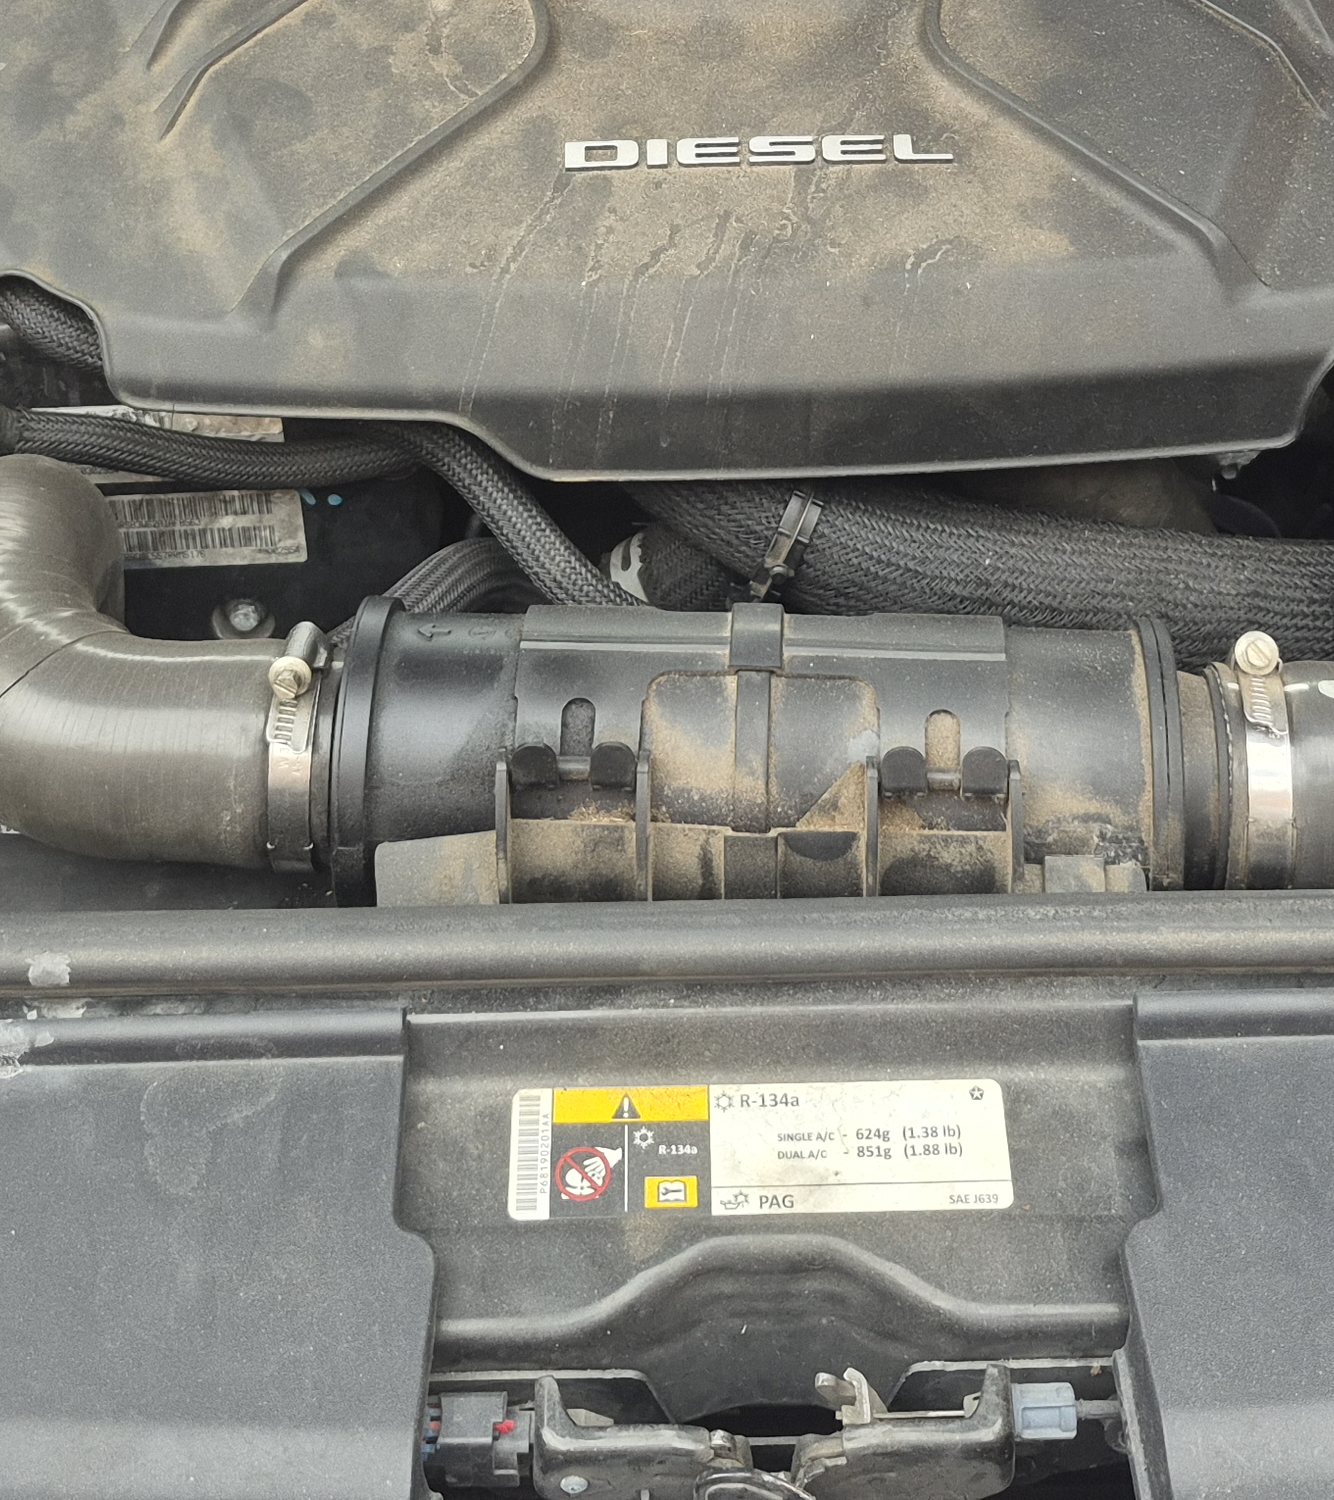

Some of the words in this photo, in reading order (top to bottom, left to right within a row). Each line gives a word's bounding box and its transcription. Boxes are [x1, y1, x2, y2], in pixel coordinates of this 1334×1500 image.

[564, 134, 955, 172] DIESEL
[740, 1092, 800, 1108] R-134a
[777, 1131, 813, 1142] SINGLE
[815, 1130, 835, 1143] A/C
[855, 1127, 891, 1143] 624g
[902, 1125, 939, 1142] (1.38
[942, 1123, 962, 1140] lb)
[539, 1112, 551, 1195] P68190201AA
[658, 1144, 698, 1155] R-134a
[777, 1150, 806, 1160] DUAL
[807, 1148, 828, 1160] A/C
[856, 1144, 892, 1160] 851g
[903, 1142, 940, 1160] (1.88
[944, 1141, 963, 1158] lb)
[758, 1193, 796, 1210] PAG
[949, 1193, 971, 1205] SAE
[973, 1192, 1000, 1205] J639
